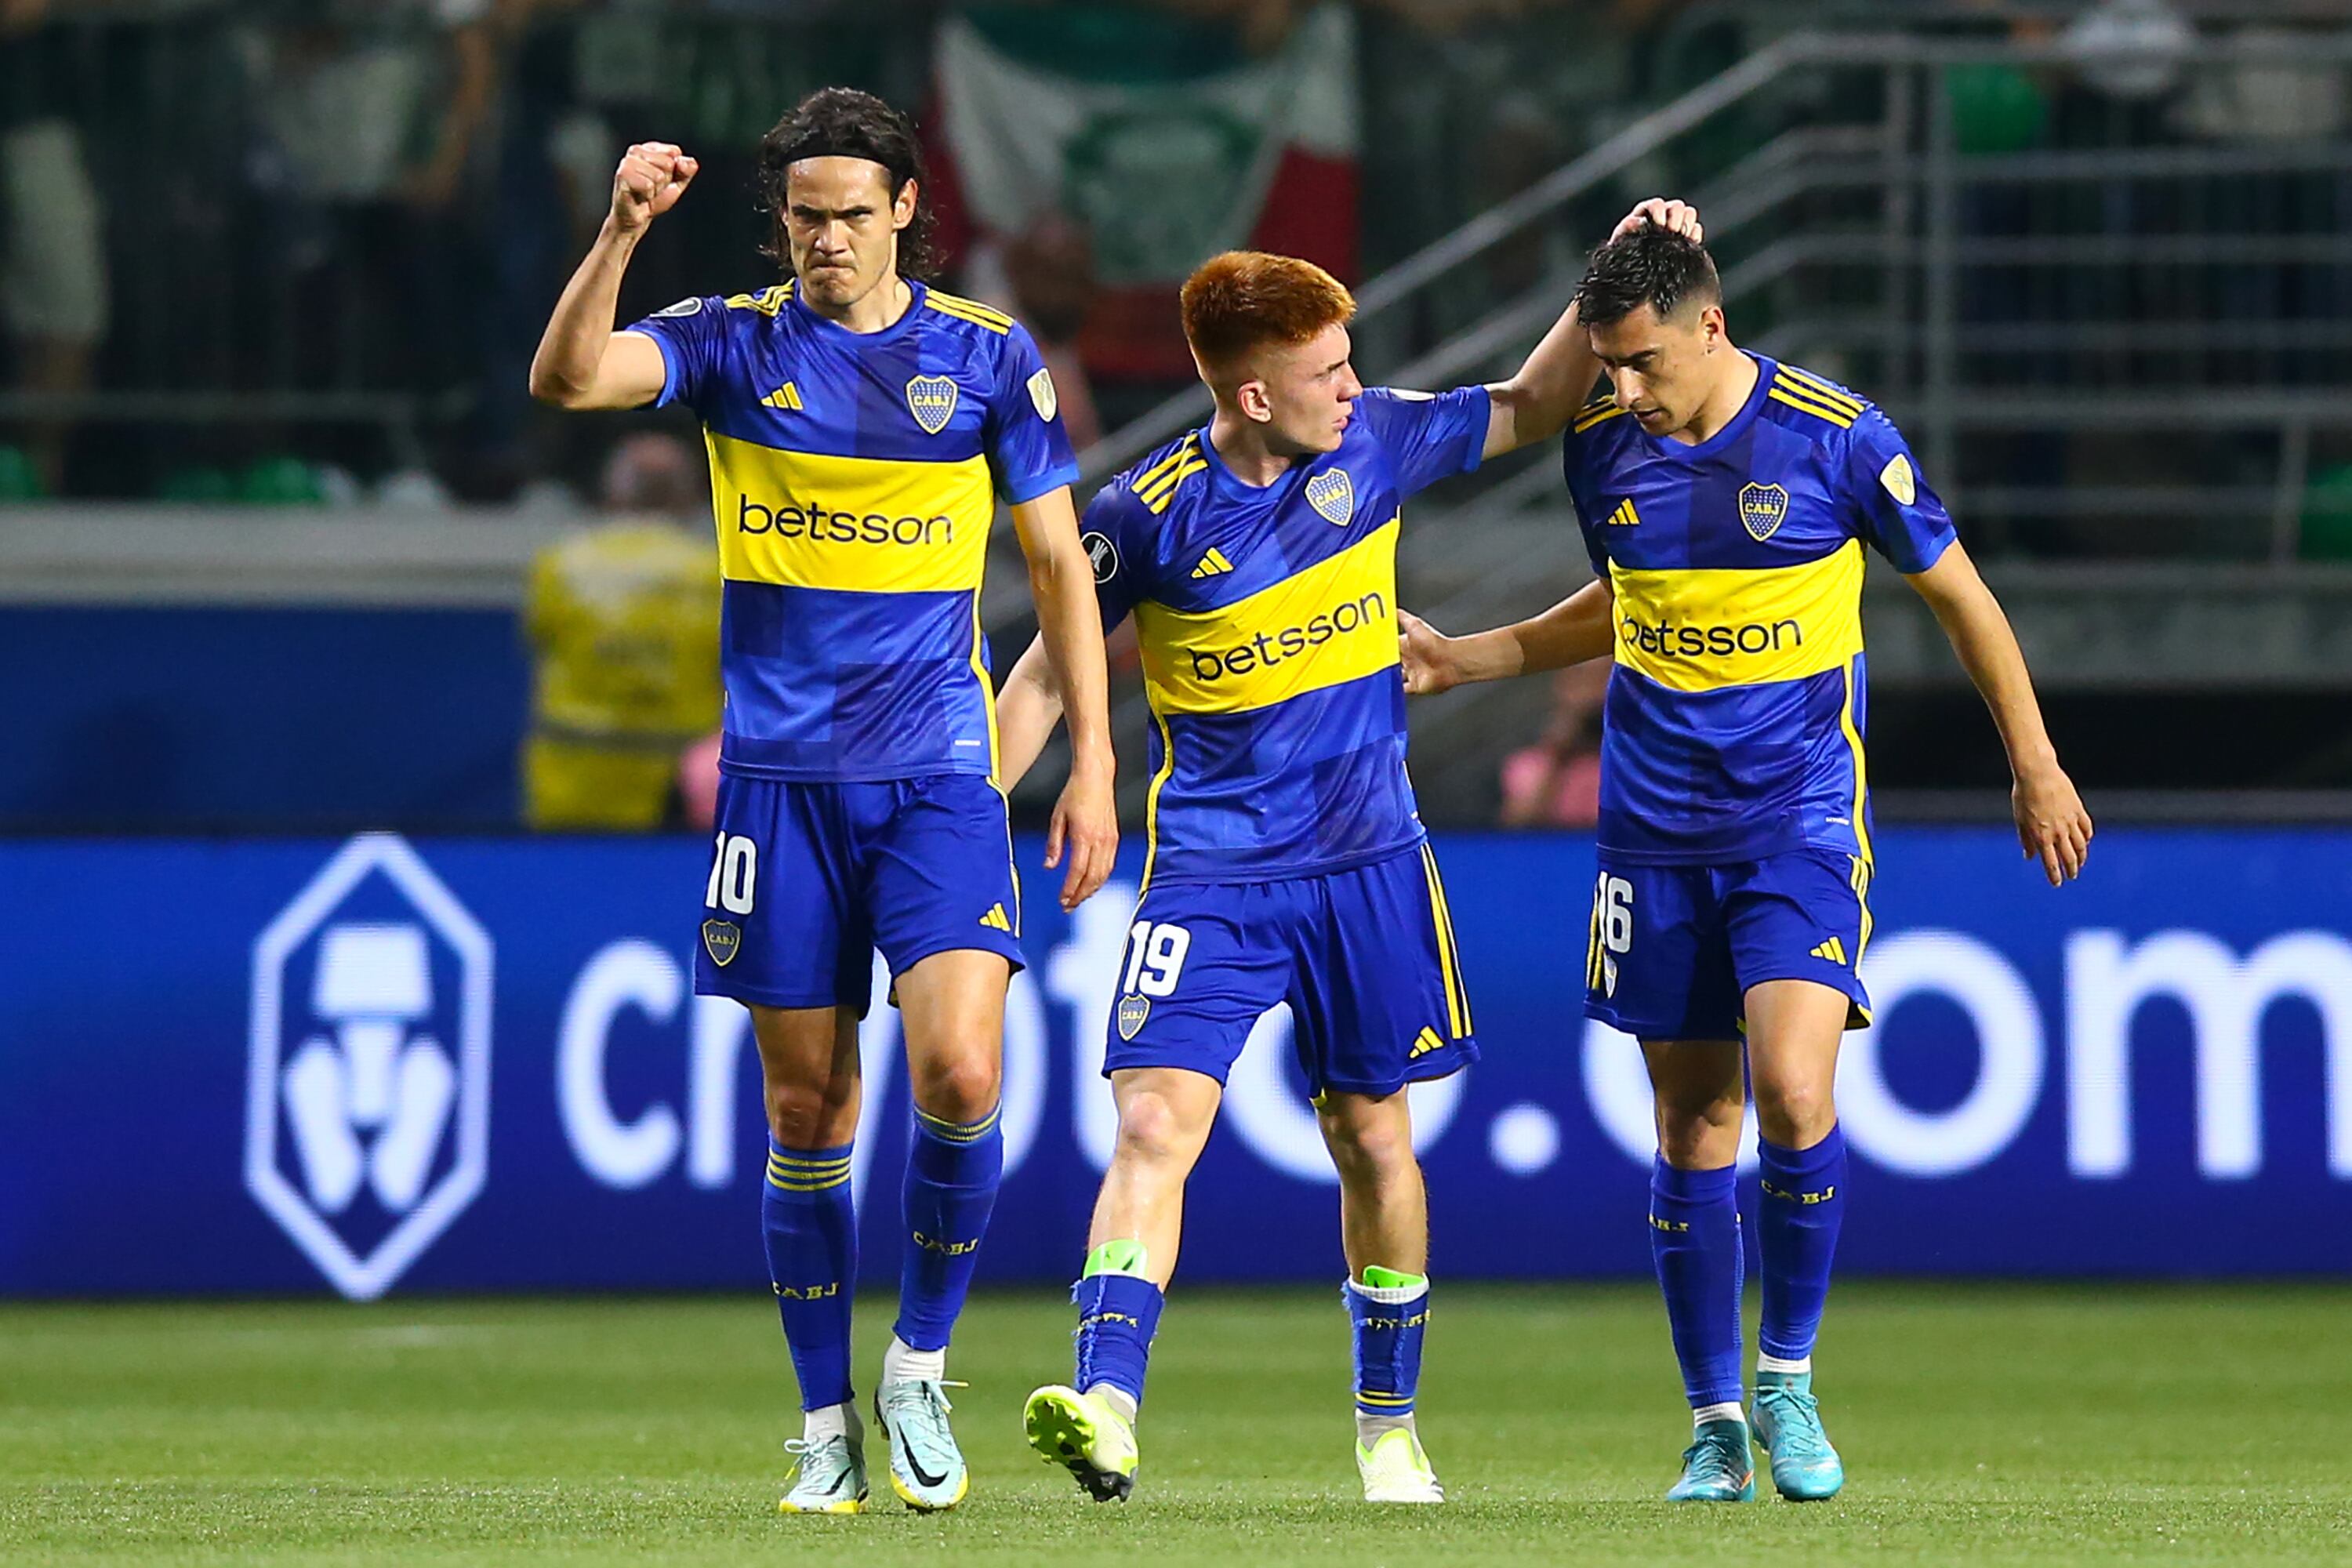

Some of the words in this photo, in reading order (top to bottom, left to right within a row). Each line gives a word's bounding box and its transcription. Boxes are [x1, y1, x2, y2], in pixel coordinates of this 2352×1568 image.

[913, 394, 950, 406] CABJ
[739, 493, 952, 545] betsson
[1744, 503, 1780, 515] CABJ
[1187, 592, 1385, 681] betsson
[706, 830, 757, 914] 10
[1599, 871, 1633, 953] 16
[1123, 920, 1191, 996] 19
